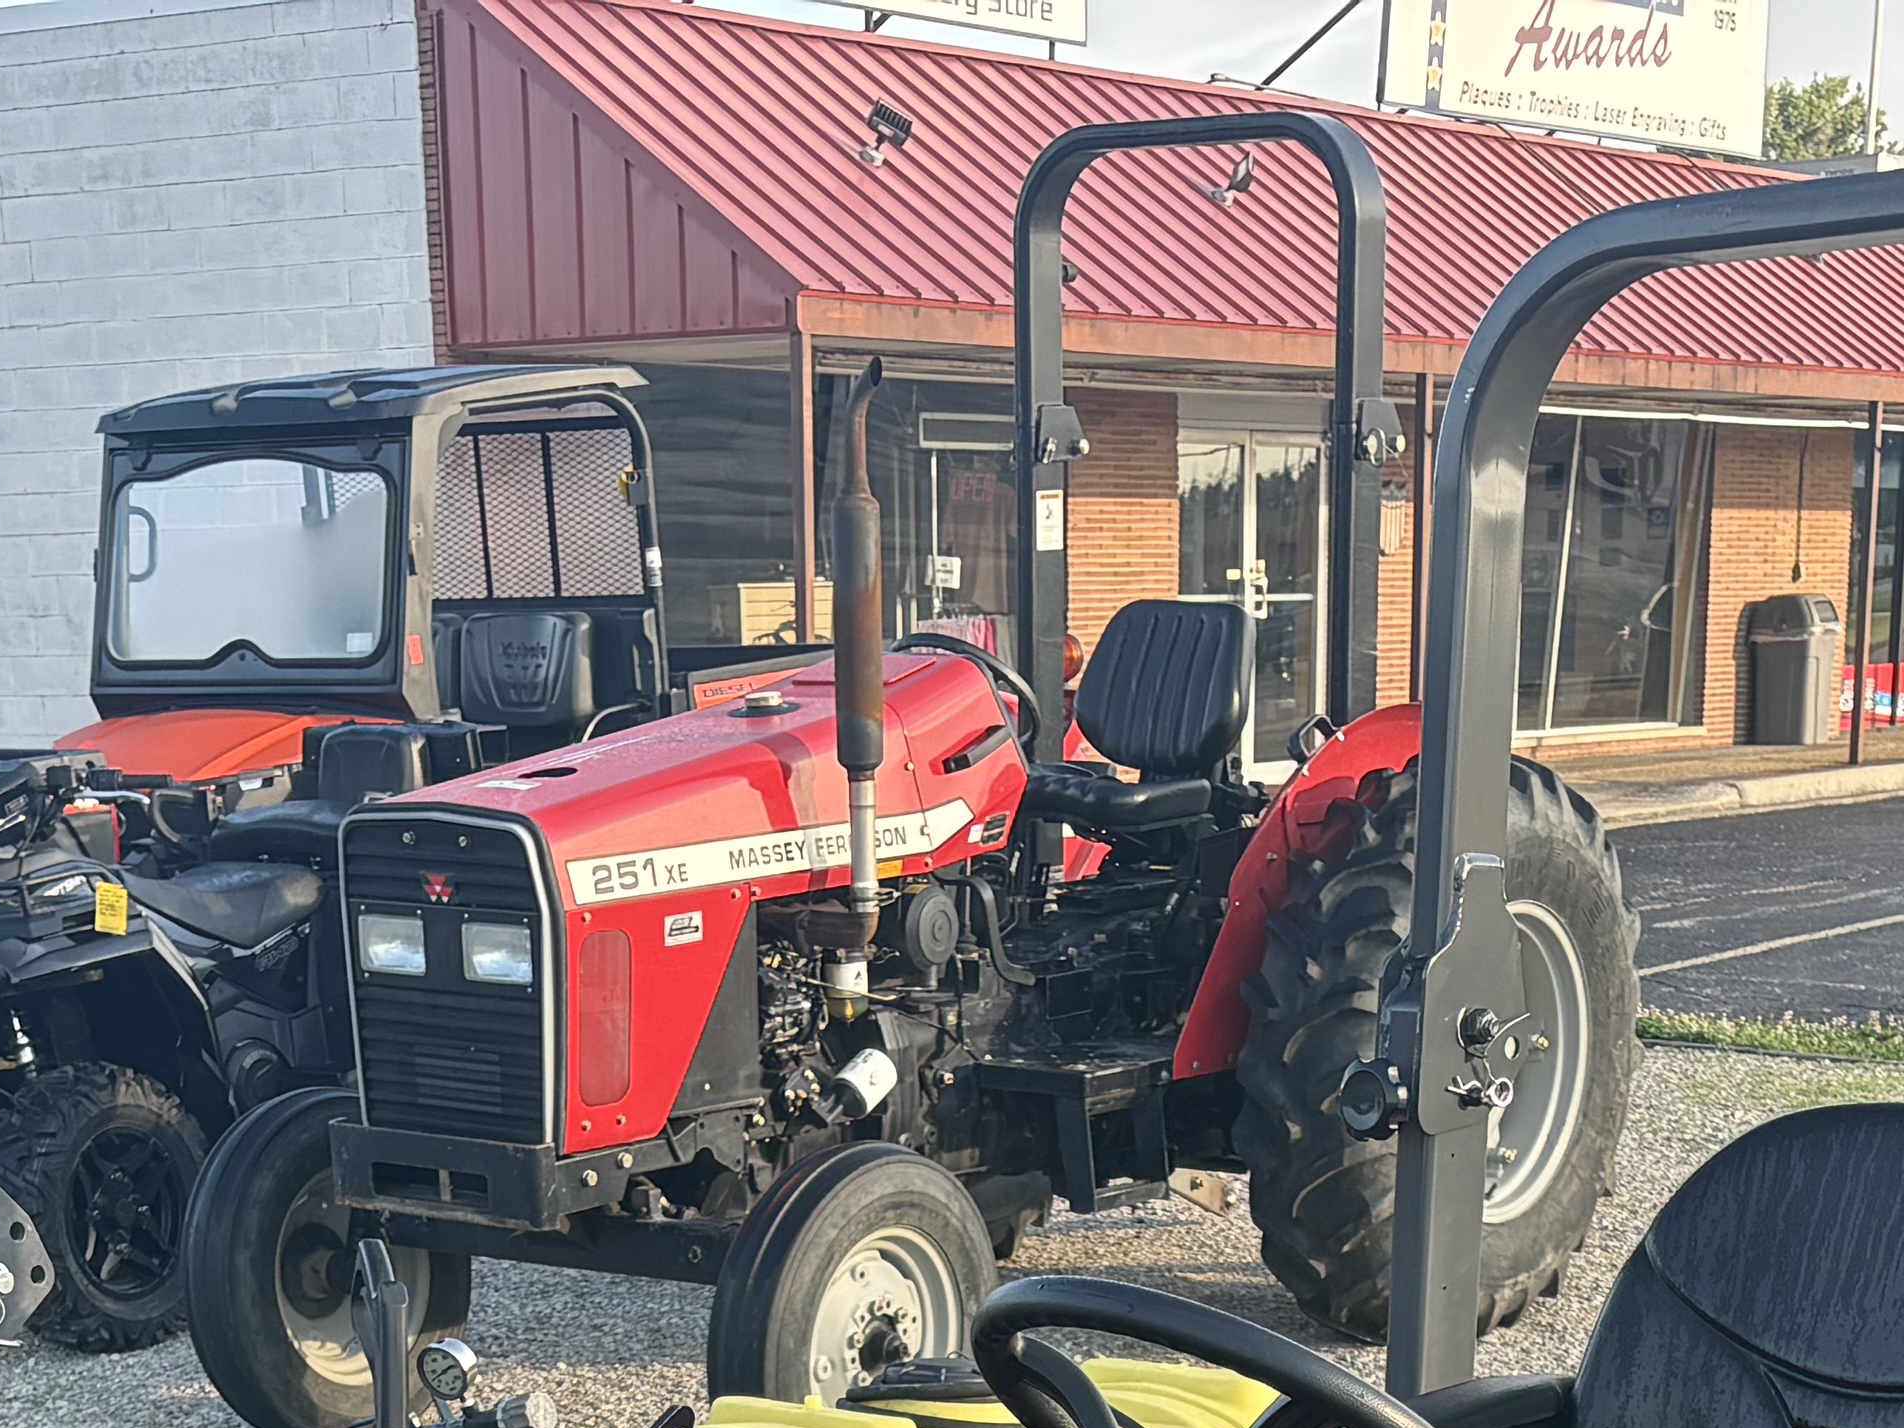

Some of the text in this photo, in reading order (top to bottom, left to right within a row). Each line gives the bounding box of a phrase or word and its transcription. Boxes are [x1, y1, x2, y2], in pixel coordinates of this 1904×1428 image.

[1504, 0, 1672, 77] Awards
[1459, 81, 1511, 110] Plaques
[1529, 91, 1580, 119] Trophies
[1594, 100, 1627, 126] Laser
[1632, 107, 1687, 137] Engraving
[1698, 115, 1727, 141] Gifts
[591, 825, 907, 895] 251 XE MASSEY FERSON
